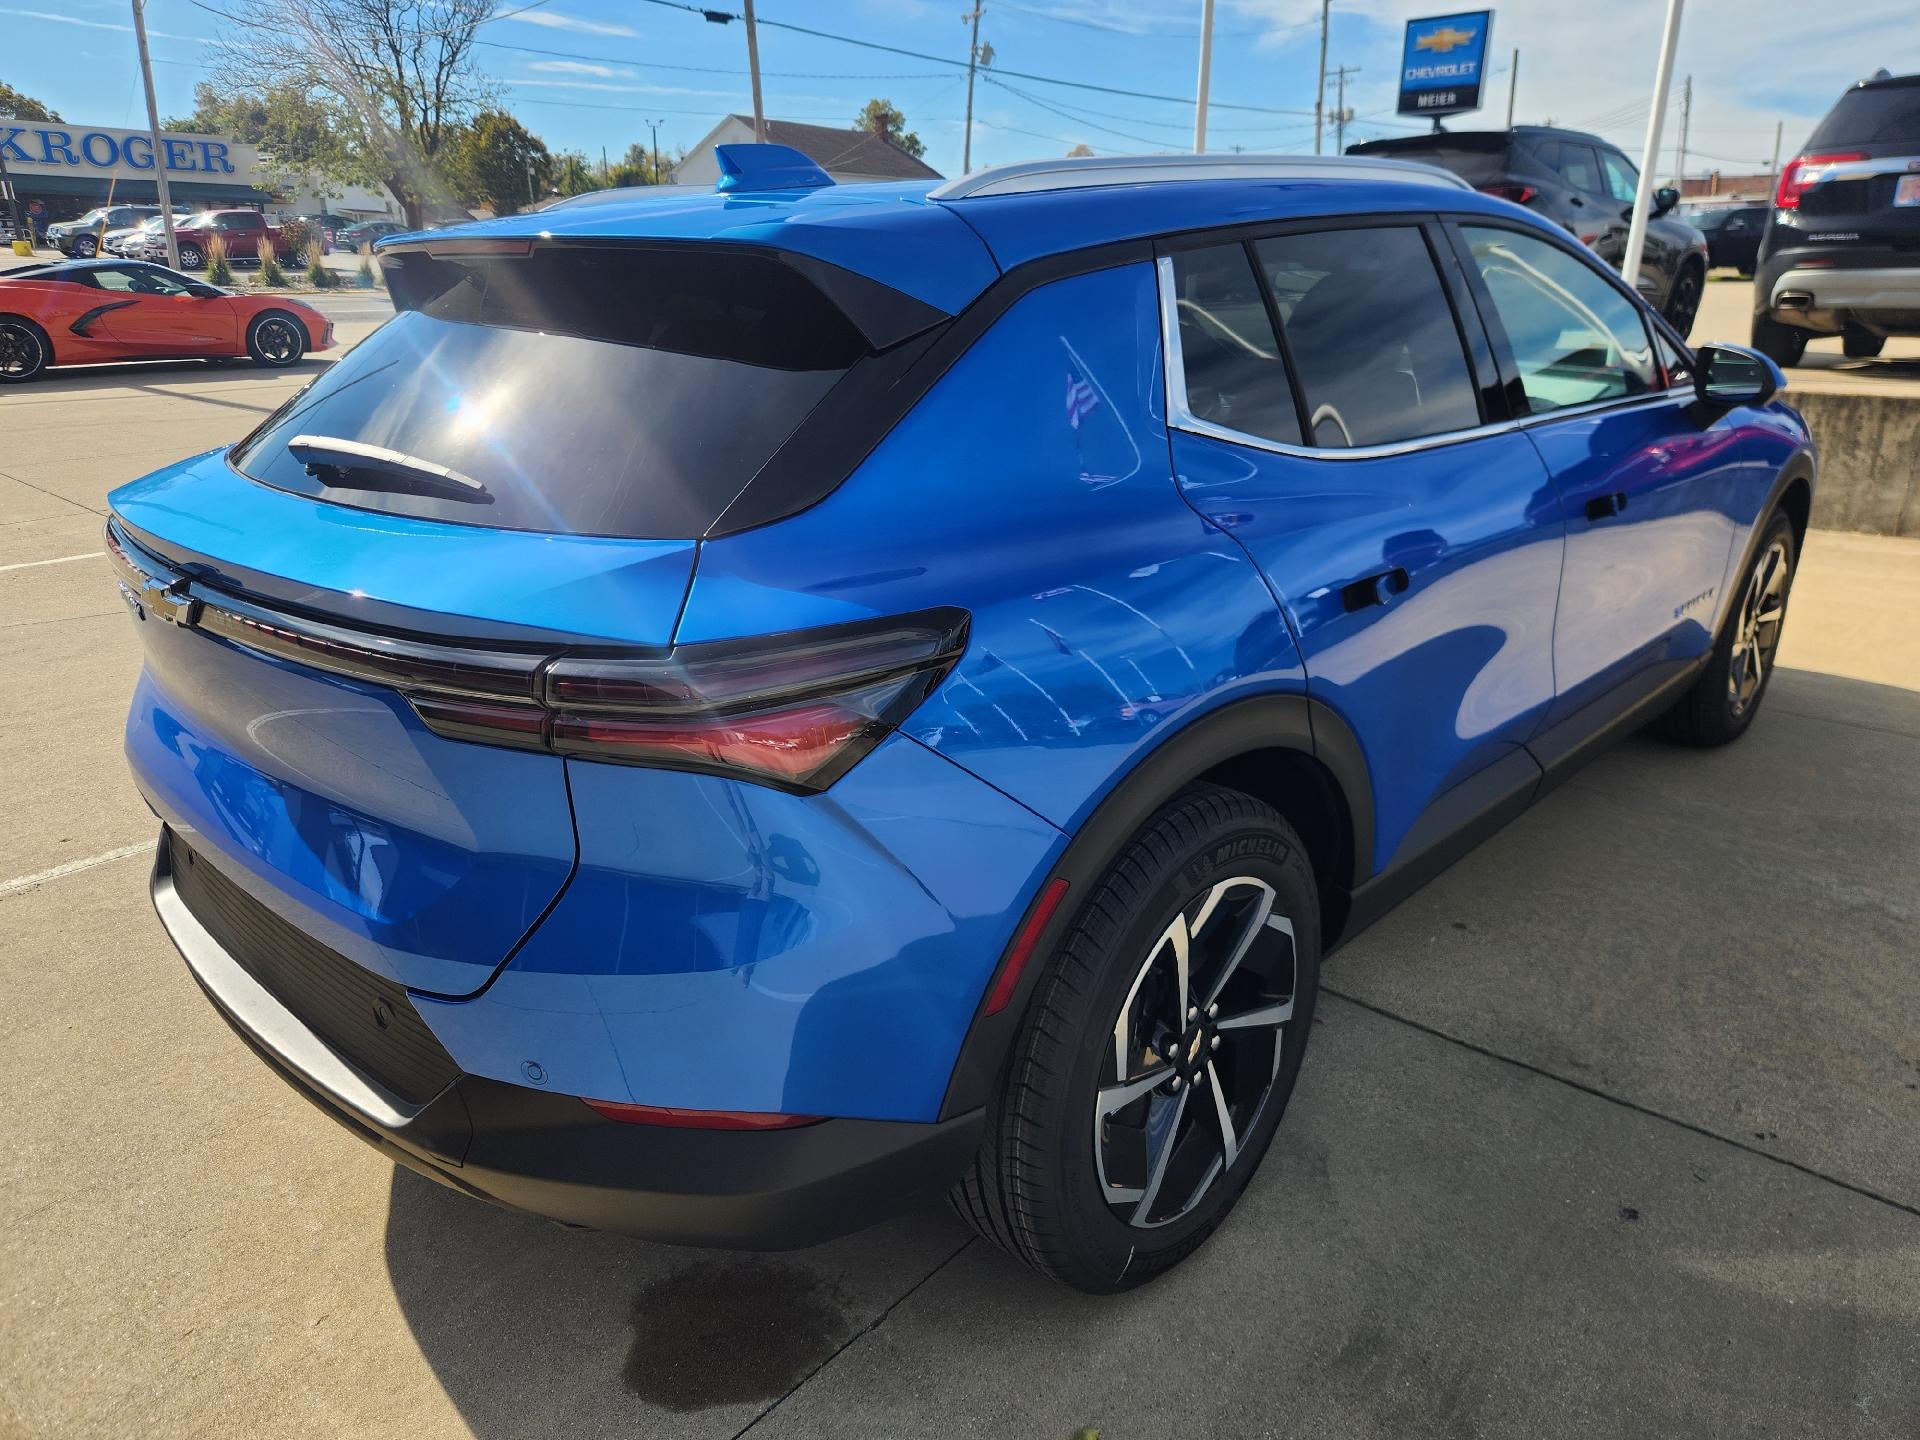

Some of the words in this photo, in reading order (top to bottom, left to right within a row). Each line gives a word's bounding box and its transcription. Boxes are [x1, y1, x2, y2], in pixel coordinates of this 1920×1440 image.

[1404, 62, 1475, 80] CHEVROLET
[1417, 91, 1456, 107] MEIER
[0, 127, 235, 174] KROGER
[1215, 838, 1287, 865] MICHELIN
